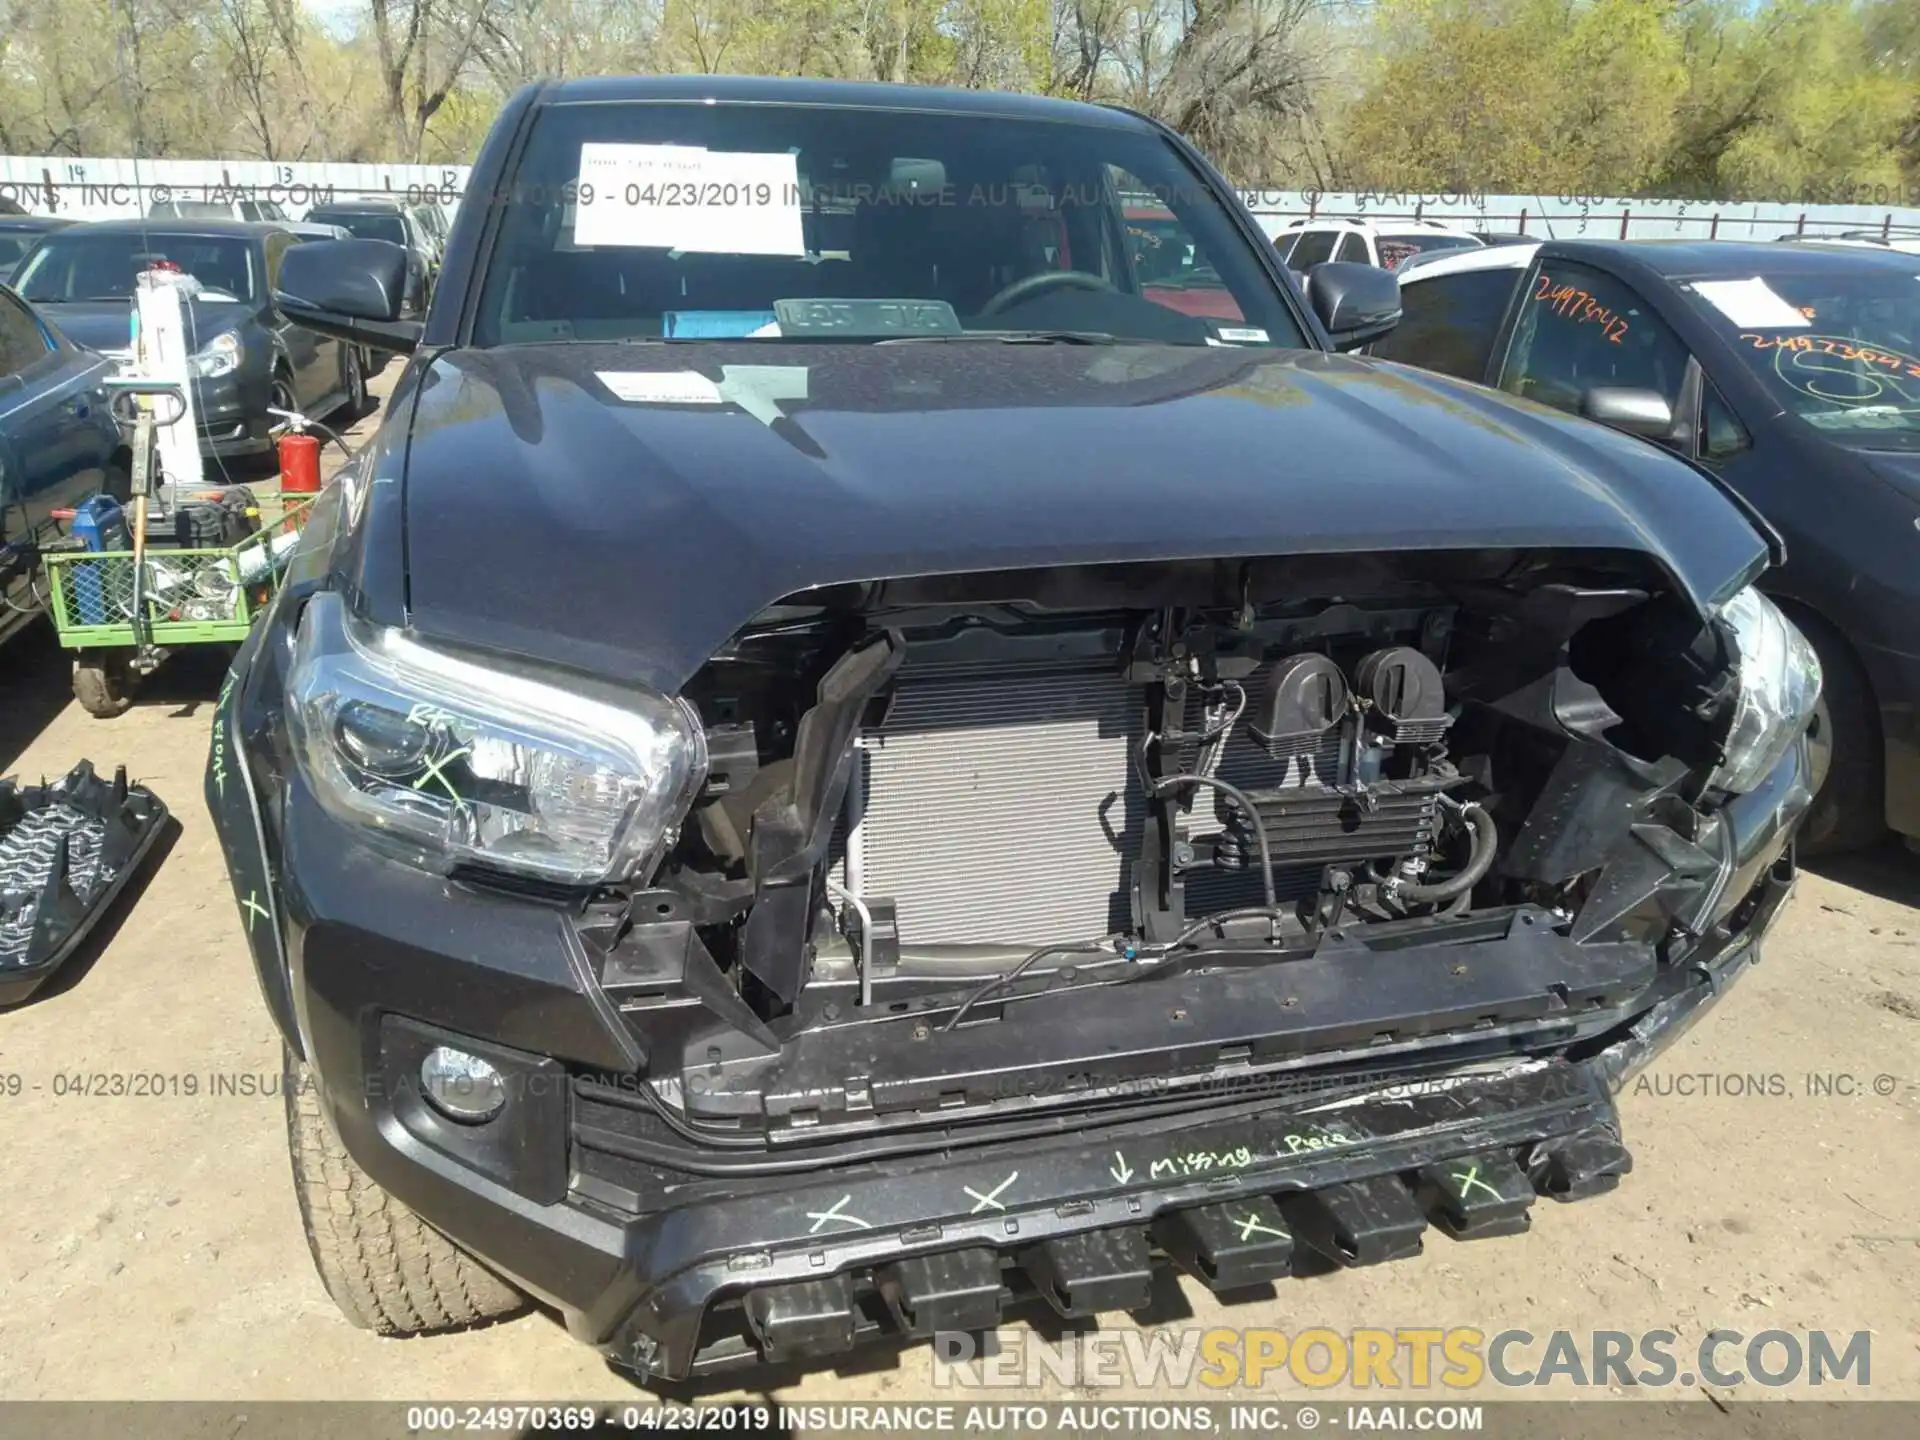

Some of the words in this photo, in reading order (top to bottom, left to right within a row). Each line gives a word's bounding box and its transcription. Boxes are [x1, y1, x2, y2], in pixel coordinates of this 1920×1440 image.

[68, 164, 86, 183] 14
[276, 166, 293, 184] 13
[442, 169, 458, 189] 12
